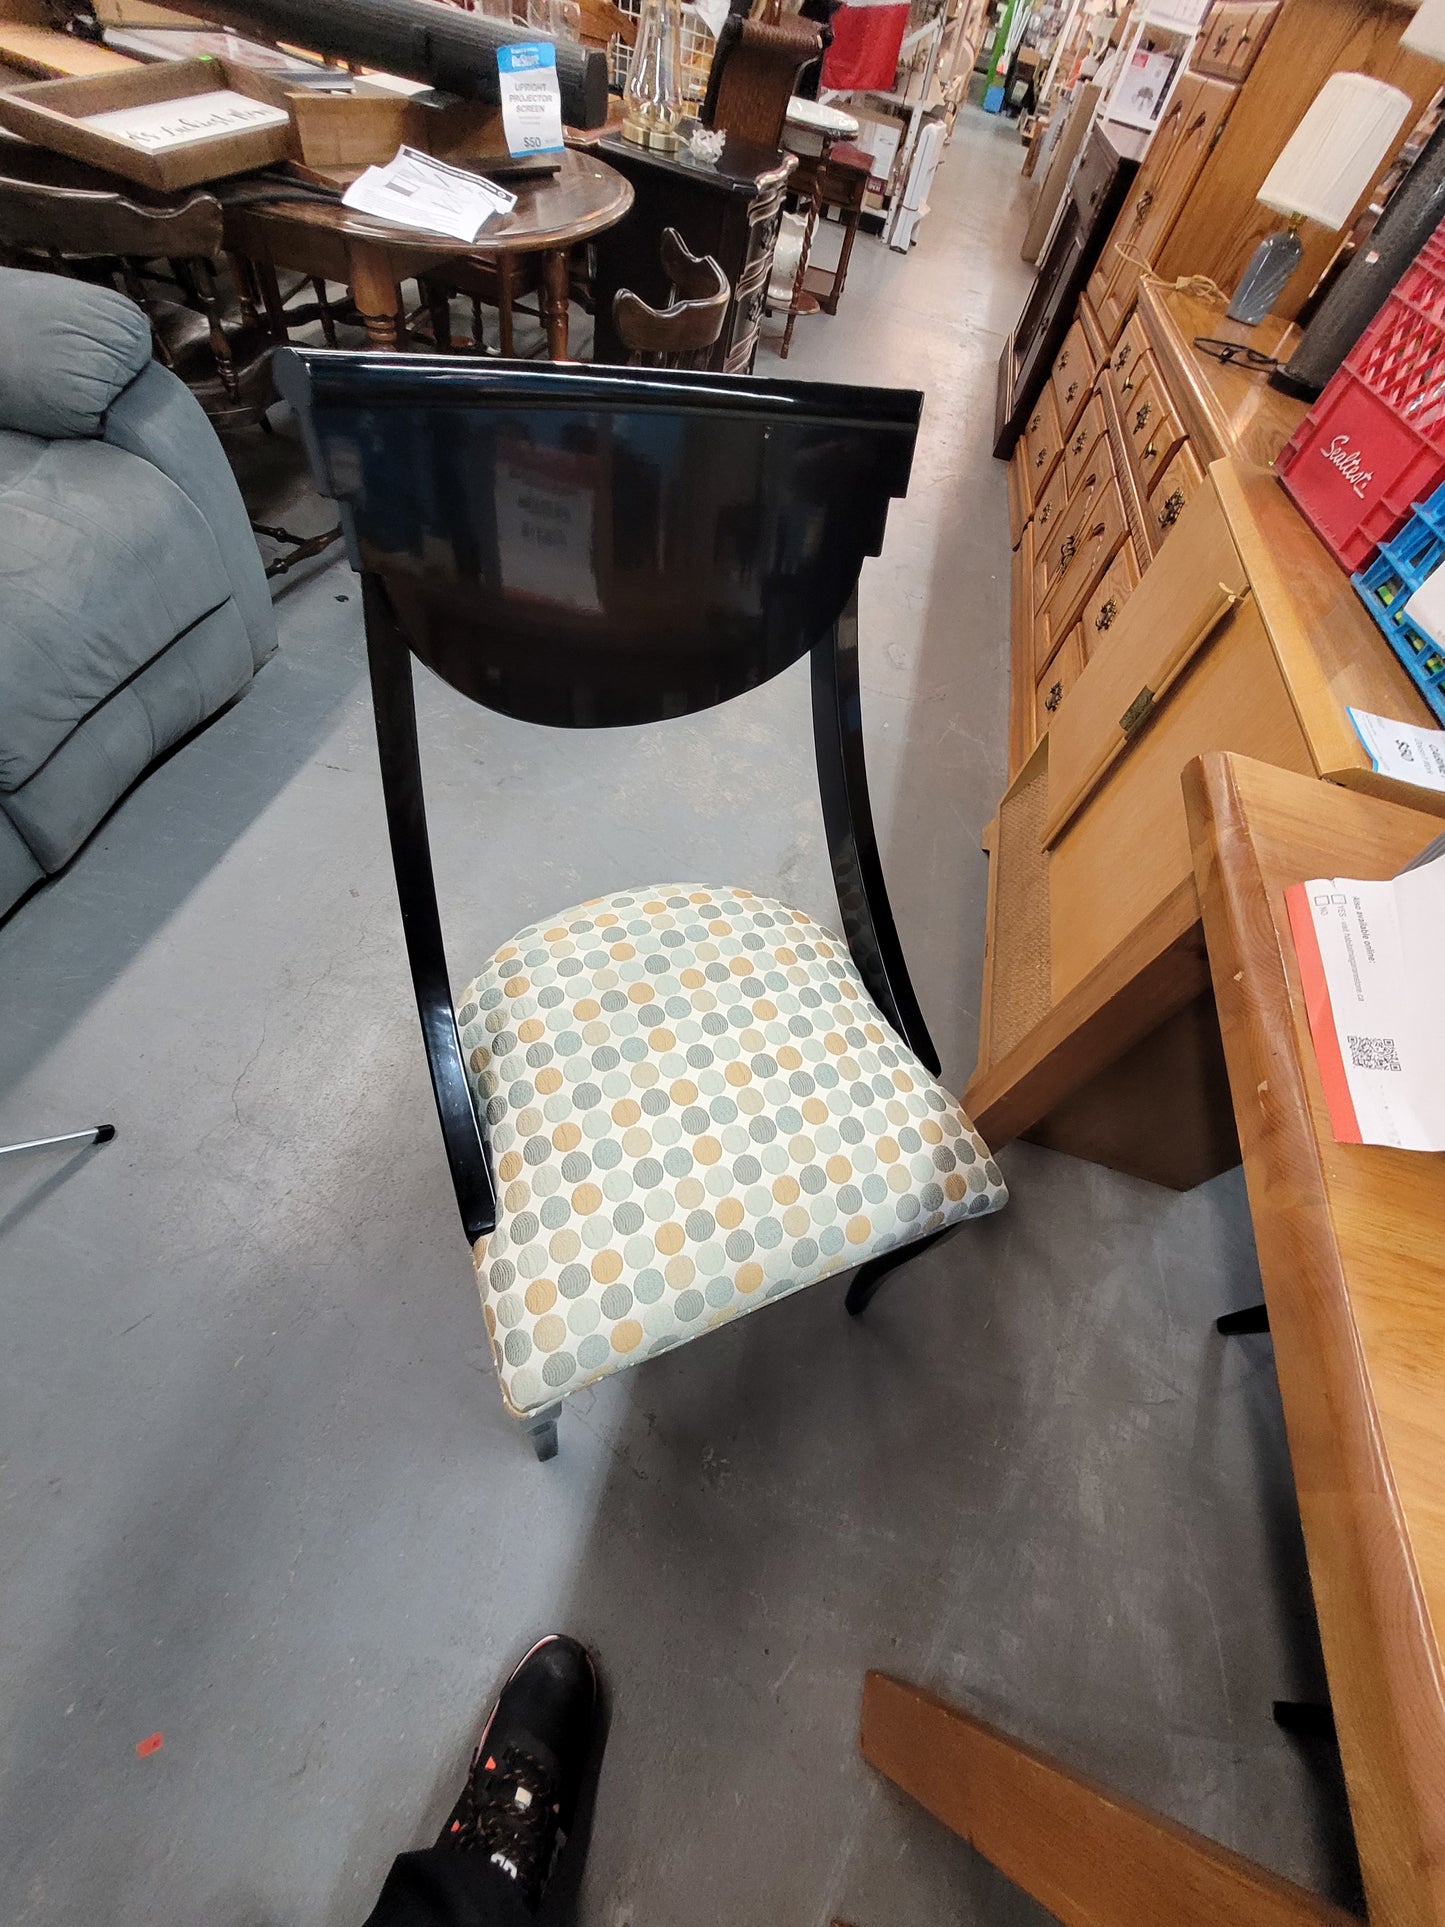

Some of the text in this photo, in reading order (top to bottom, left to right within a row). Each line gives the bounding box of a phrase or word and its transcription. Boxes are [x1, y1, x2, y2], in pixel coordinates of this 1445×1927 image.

[514, 83, 548, 91] UPRIGHT
[508, 94, 553, 103] PROJECTOR
[516, 104, 546, 113] SCREEN
[523, 136, 542, 148] $50
[1320, 434, 1374, 499] Sealtest
[1320, 906, 1329, 917] NO
[1337, 904, 1347, 917] YES
[1352, 896, 1376, 964] Also available online:
